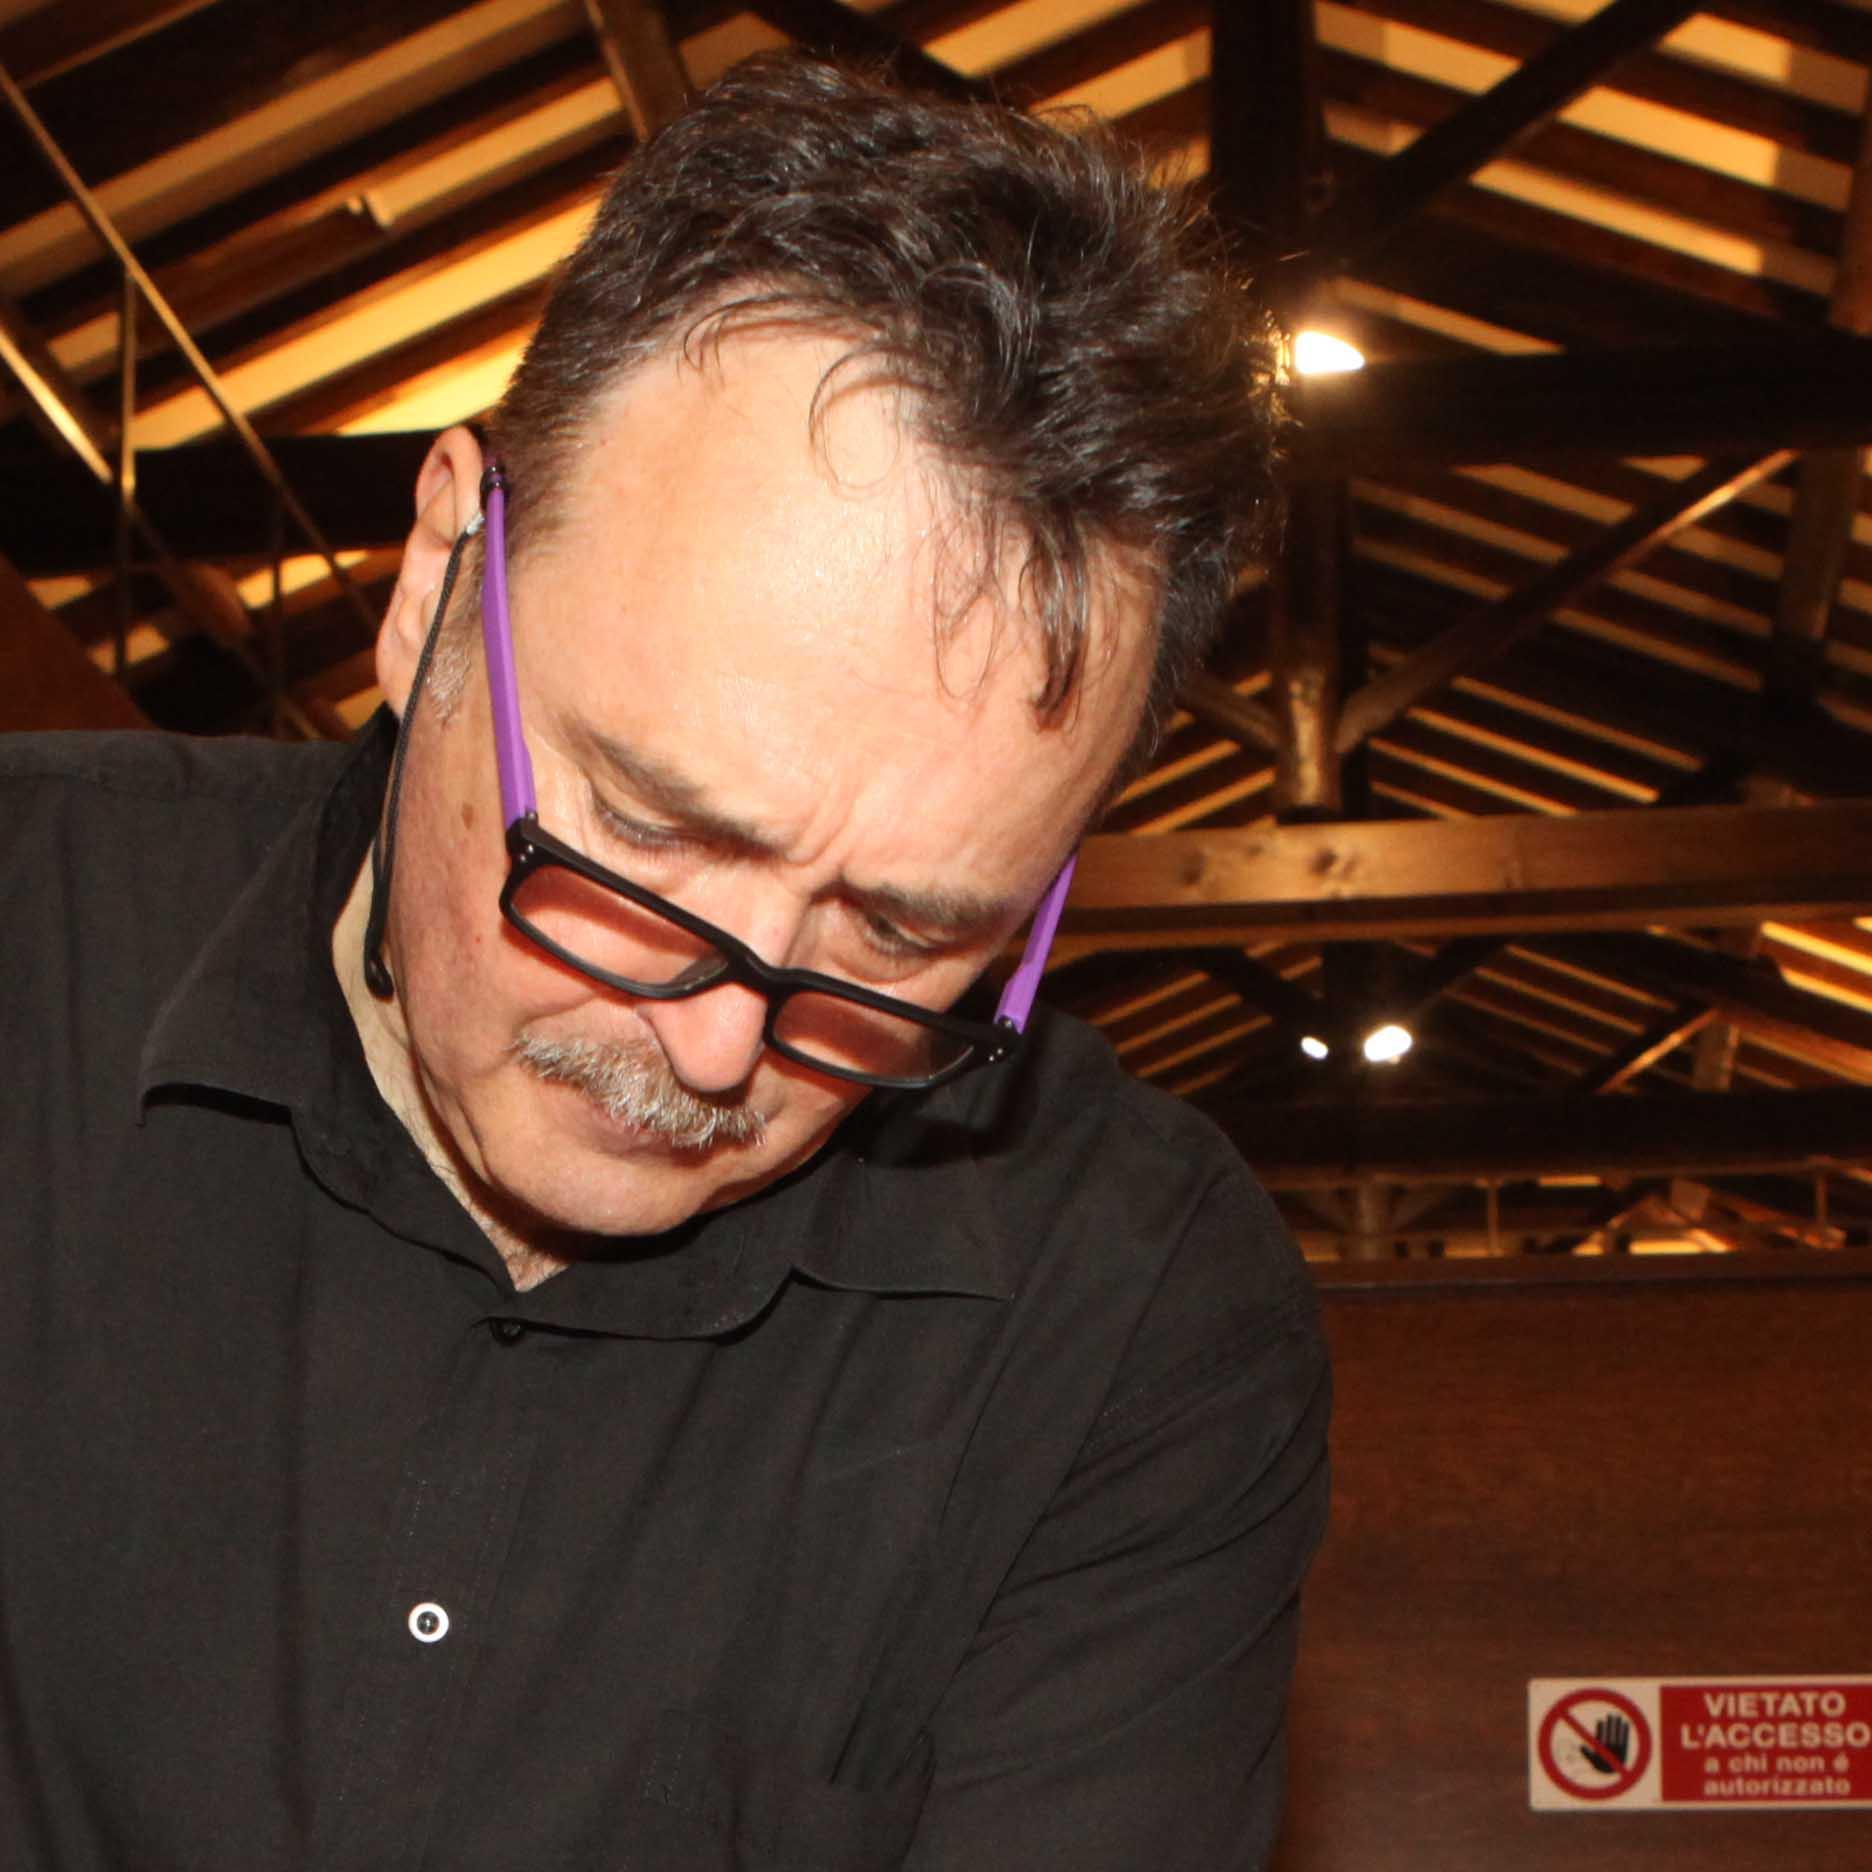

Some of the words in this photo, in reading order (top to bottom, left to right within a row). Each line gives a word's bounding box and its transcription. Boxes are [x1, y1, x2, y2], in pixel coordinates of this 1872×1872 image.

[1703, 1691, 1847, 1718] VIETATO
[1681, 1721, 1872, 1749] L'ACCESSO
[1704, 1756, 1720, 1774] a
[1729, 1752, 1768, 1773] chi
[1776, 1755, 1825, 1773] non
[1704, 1775, 1851, 1796] autorizzato
